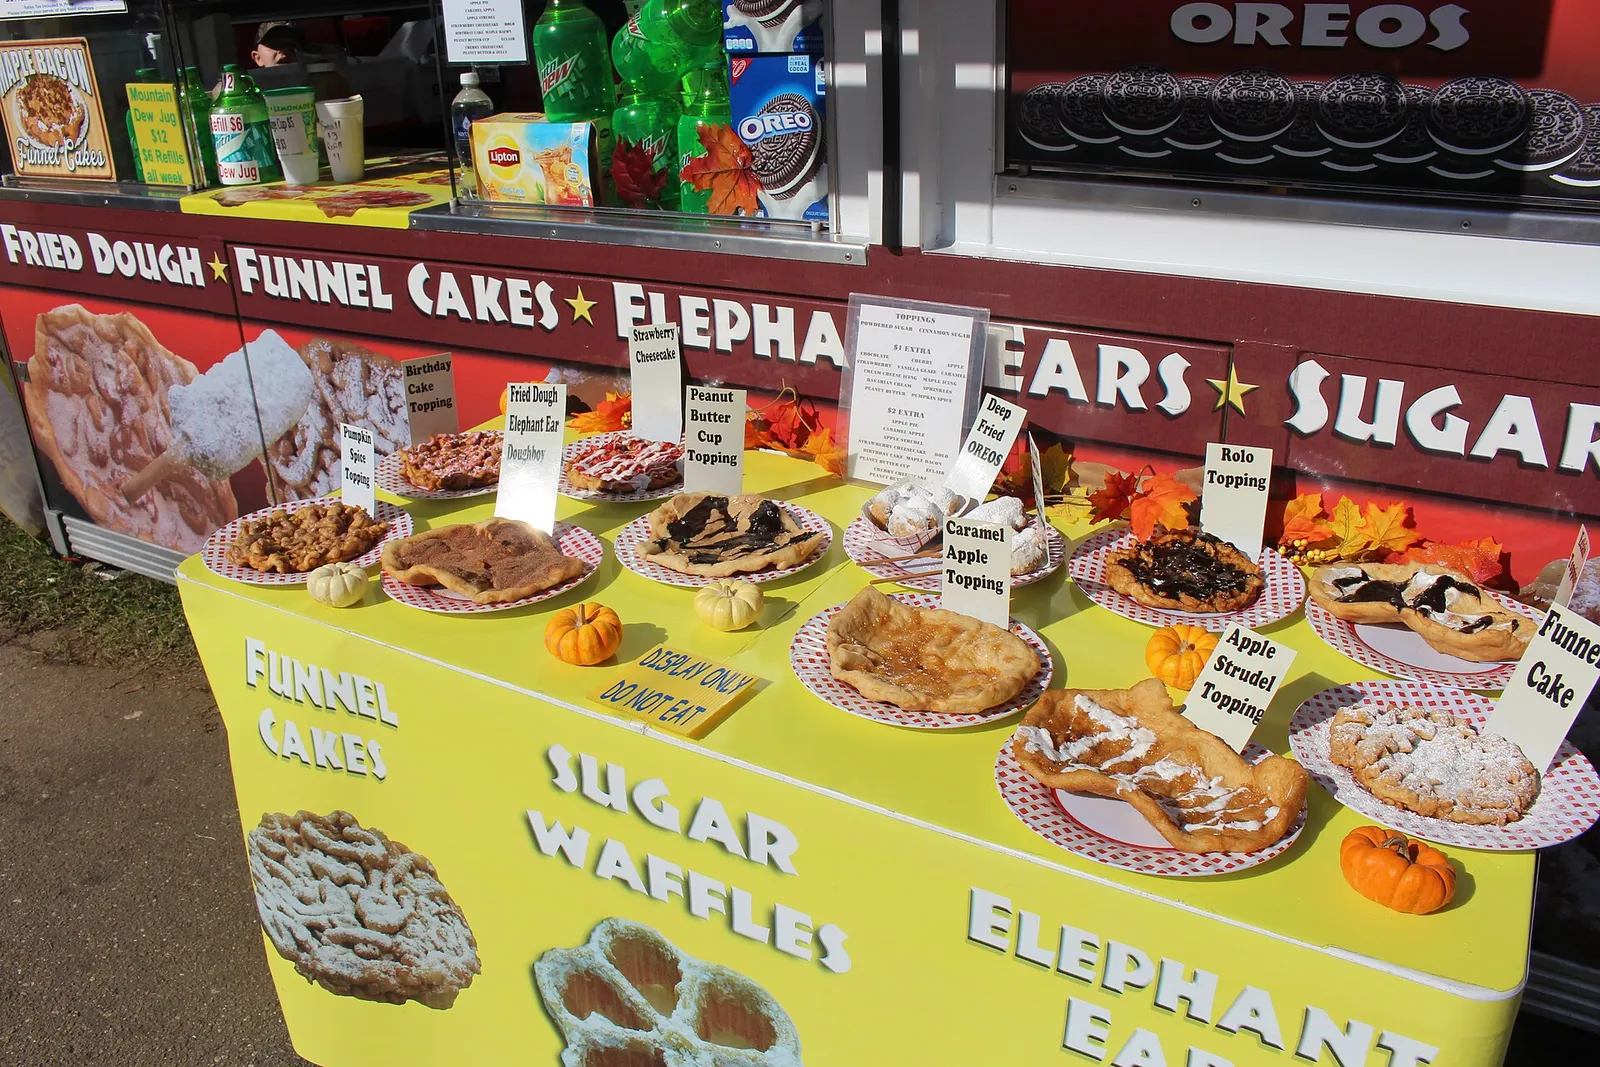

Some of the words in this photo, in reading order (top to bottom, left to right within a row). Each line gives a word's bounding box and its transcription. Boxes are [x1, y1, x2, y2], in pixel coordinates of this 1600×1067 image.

[1170, 3, 1470, 50] OREOS
[0, 49, 37, 98] MAPLE
[34, 47, 93, 96] BACON
[129, 88, 172, 102] Mountain
[134, 108, 154, 122] Dew
[160, 109, 176, 127] Jug
[230, 116, 243, 131] $6
[741, 113, 810, 141] OREO
[150, 129, 168, 144] $12
[17, 137, 61, 169] Funnel
[60, 136, 106, 172] Cakes
[142, 148, 154, 162] $6
[154, 149, 184, 165] Refills
[491, 152, 518, 163] Lipton
[147, 168, 158, 182] all
[160, 170, 184, 184] week
[218, 163, 236, 179] Dew
[238, 162, 257, 181] Jug
[0, 223, 83, 271] FRIED
[86, 232, 206, 287] DOUGH
[233, 245, 393, 312] FUNNEL
[407, 262, 559, 332] CAKES
[861, 320, 893, 329] POWDERED
[896, 313, 936, 324] TOPPINGS
[633, 327, 676, 342] Strawberry
[919, 328, 950, 336] CINNAMON
[611, 281, 849, 371] ELEPHA
[983, 324, 1192, 416] EARS
[636, 348, 676, 363] Cheesecake
[905, 346, 931, 355] EXTRA
[406, 359, 452, 377] Birthday
[857, 360, 892, 368] STRAWBERRY
[408, 382, 434, 395] Cake
[510, 386, 530, 403] Fried
[532, 387, 558, 407] Dough
[690, 388, 734, 403] Peanut
[923, 386, 952, 394] SPRINKLES
[410, 396, 452, 413] Topping
[898, 409, 924, 418] EXTRA
[986, 398, 1012, 422] Deep
[508, 414, 544, 436] Elephant
[545, 418, 559, 433] Ear
[690, 409, 731, 423] Butter
[1284, 359, 1600, 473] SUGAR
[343, 426, 372, 445] Pumpkin
[698, 430, 722, 445] Cup
[977, 419, 1006, 442] Fried
[349, 448, 366, 464] Spice
[506, 443, 546, 463] Doughboy
[859, 439, 892, 449] STRAWBERRY
[893, 445, 926, 454] CHEESECAKE
[863, 448, 888, 457] BIRTHDAY
[967, 440, 1004, 467] OREOS
[1221, 447, 1254, 464] Rolo
[687, 449, 738, 466] Topping
[345, 468, 370, 489] Topping
[1207, 469, 1267, 492] Topping
[946, 520, 1004, 542] Caramel
[946, 544, 988, 566] Apple
[946, 569, 1004, 594] Topping
[1226, 628, 1276, 659] Apple
[639, 647, 712, 681] DISPLAY
[700, 667, 754, 695] ONLY
[1214, 655, 1277, 692] Strudel
[245, 636, 398, 730] FUNNEL
[1527, 660, 1574, 708] Cake
[600, 679, 638, 703] DO
[623, 687, 675, 715] NOT
[658, 699, 706, 726] EAT
[1201, 681, 1265, 725] Topping
[258, 706, 387, 782] CAKES
[547, 743, 799, 876] SUGAR
[526, 809, 852, 975] WAFFLES
[967, 886, 1440, 1067] ELEPHANT
